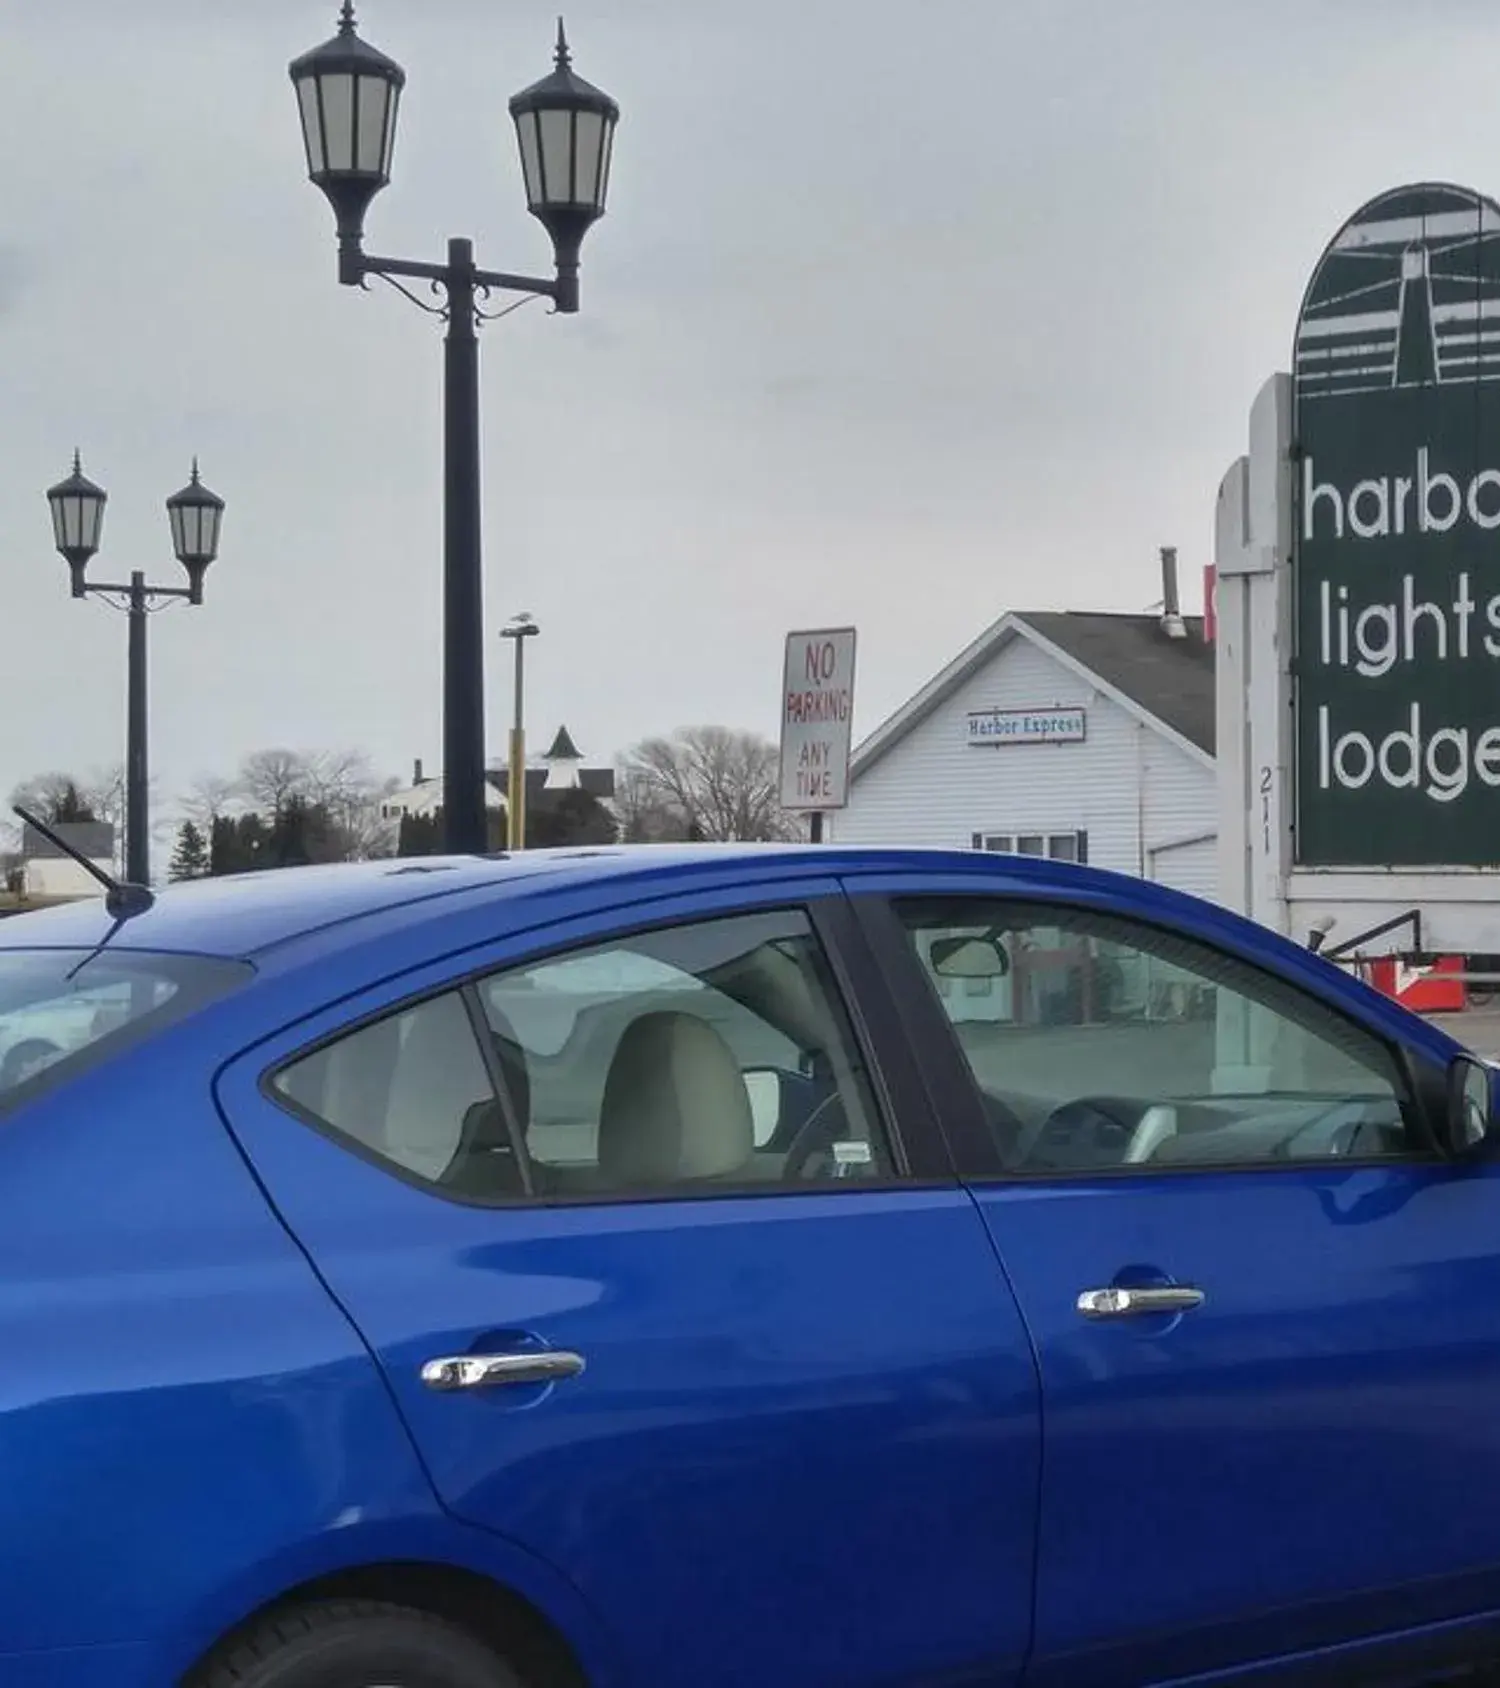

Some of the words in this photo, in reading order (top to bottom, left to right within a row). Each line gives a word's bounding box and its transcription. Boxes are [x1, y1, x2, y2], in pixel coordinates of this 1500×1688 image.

[804, 641, 836, 680] NO
[787, 689, 849, 724] PARKING
[969, 717, 1017, 735] Harbor
[799, 741, 832, 767] ANY
[797, 770, 832, 797] TIME
